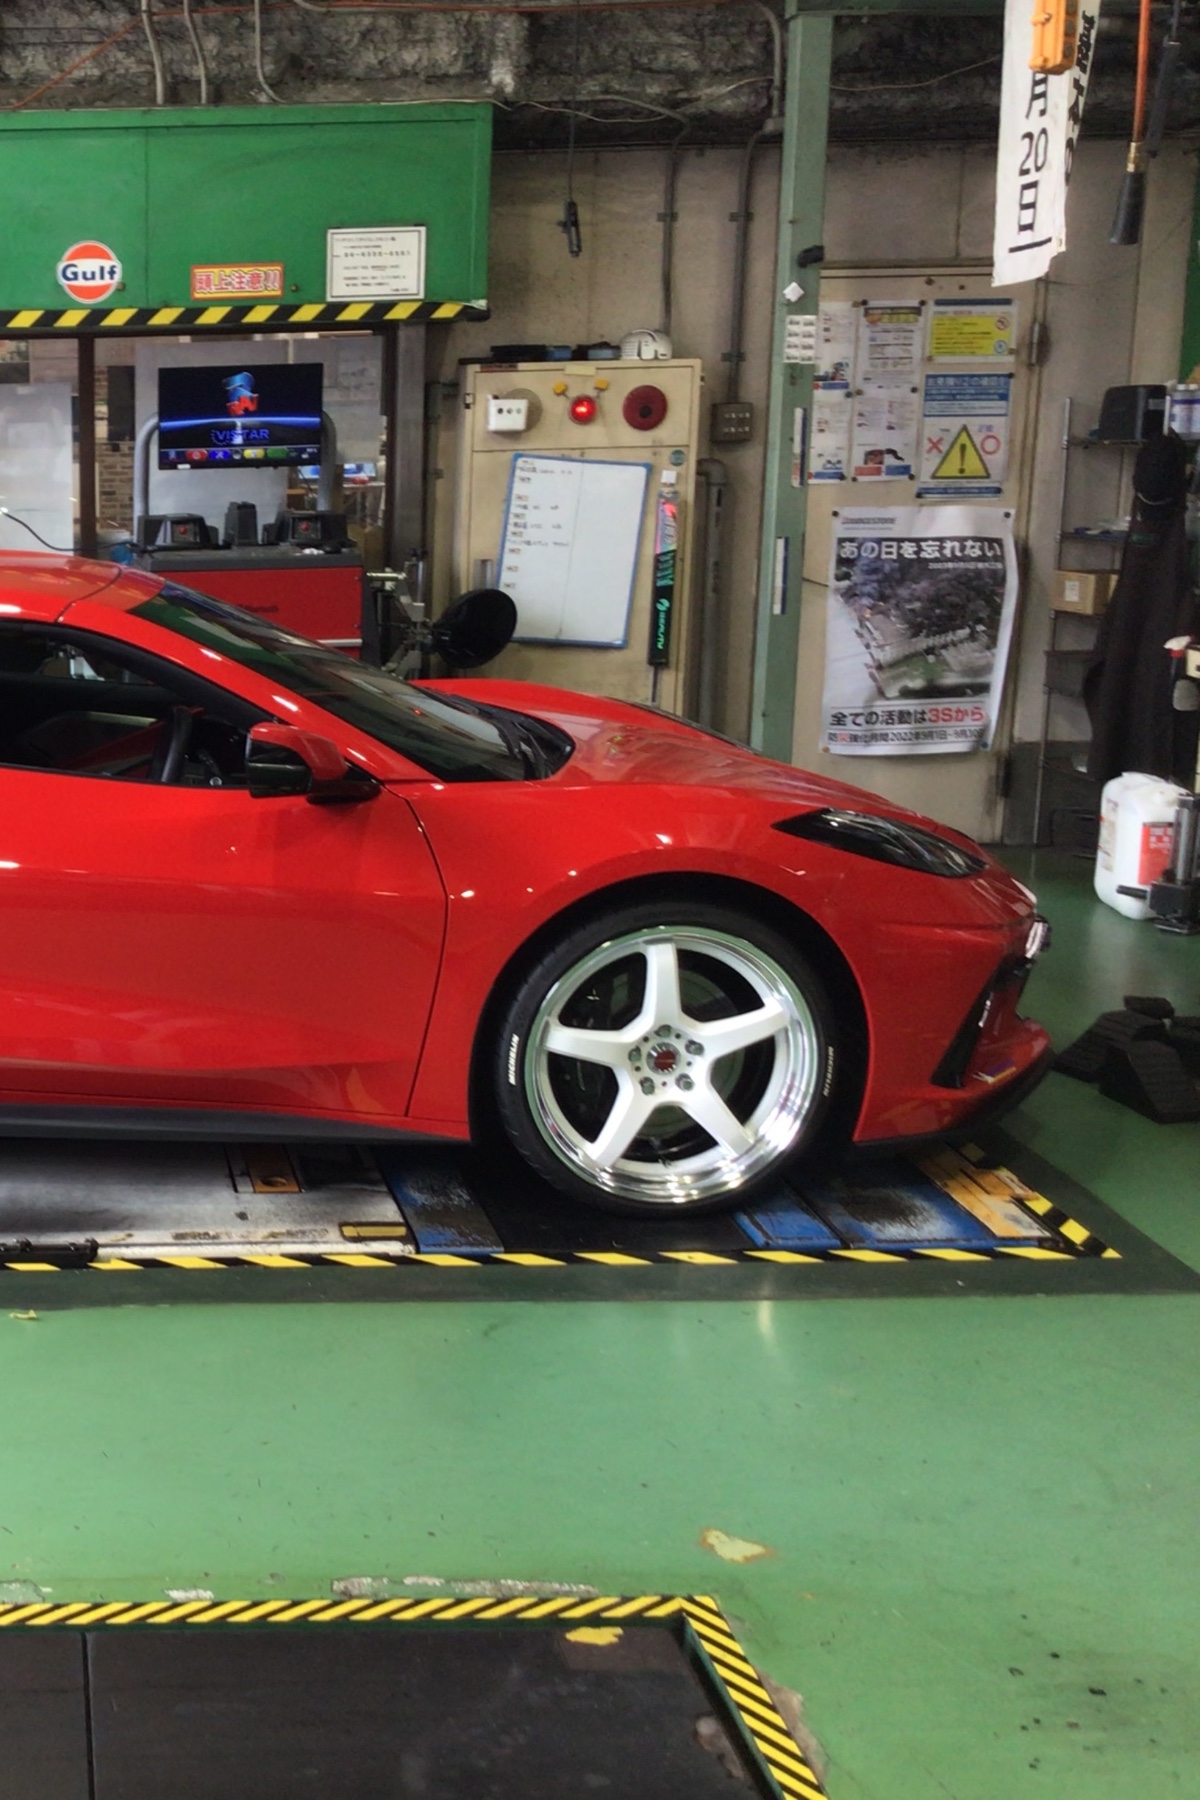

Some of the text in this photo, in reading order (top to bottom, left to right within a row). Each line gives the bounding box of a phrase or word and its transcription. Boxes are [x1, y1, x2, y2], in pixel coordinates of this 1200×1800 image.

[61, 264, 118, 282] Gulf
[840, 540, 1002, 560] あの日を忘れない
[830, 707, 984, 727] 全ての活動は3Sから
